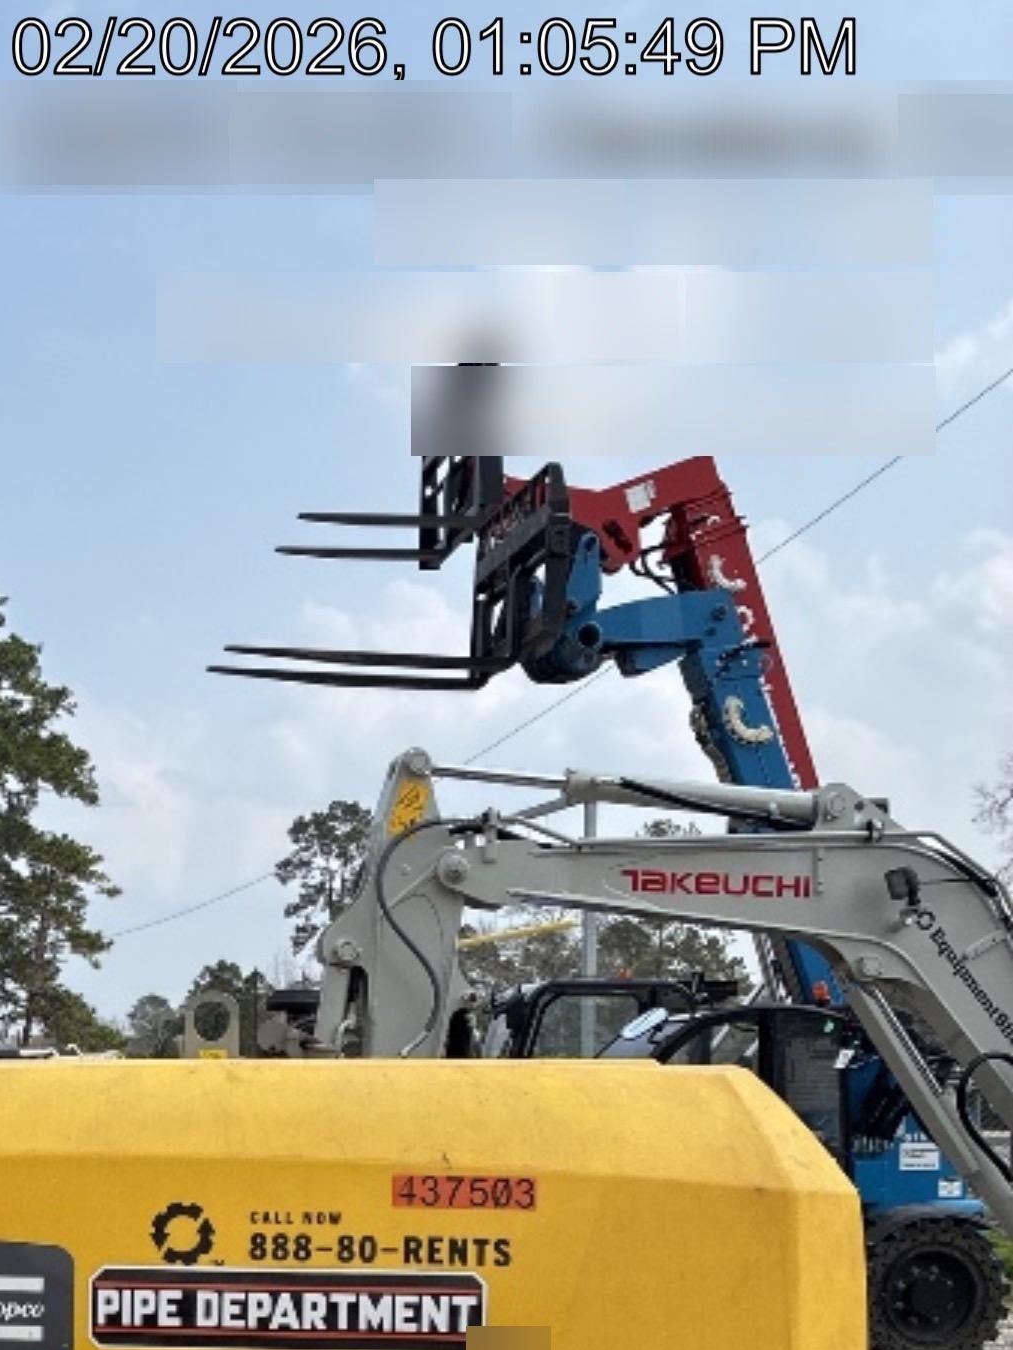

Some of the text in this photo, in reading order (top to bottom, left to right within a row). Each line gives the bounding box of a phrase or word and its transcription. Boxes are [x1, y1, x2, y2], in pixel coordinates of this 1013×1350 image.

[621, 869, 811, 898] TAKEUCHI
[398, 1174, 536, 1210] 437503
[250, 1210, 342, 1225] CALL NOW
[249, 1232, 512, 1267] 888-80-RENTS
[97, 1289, 477, 1333] PIPE DEPARTMENT
